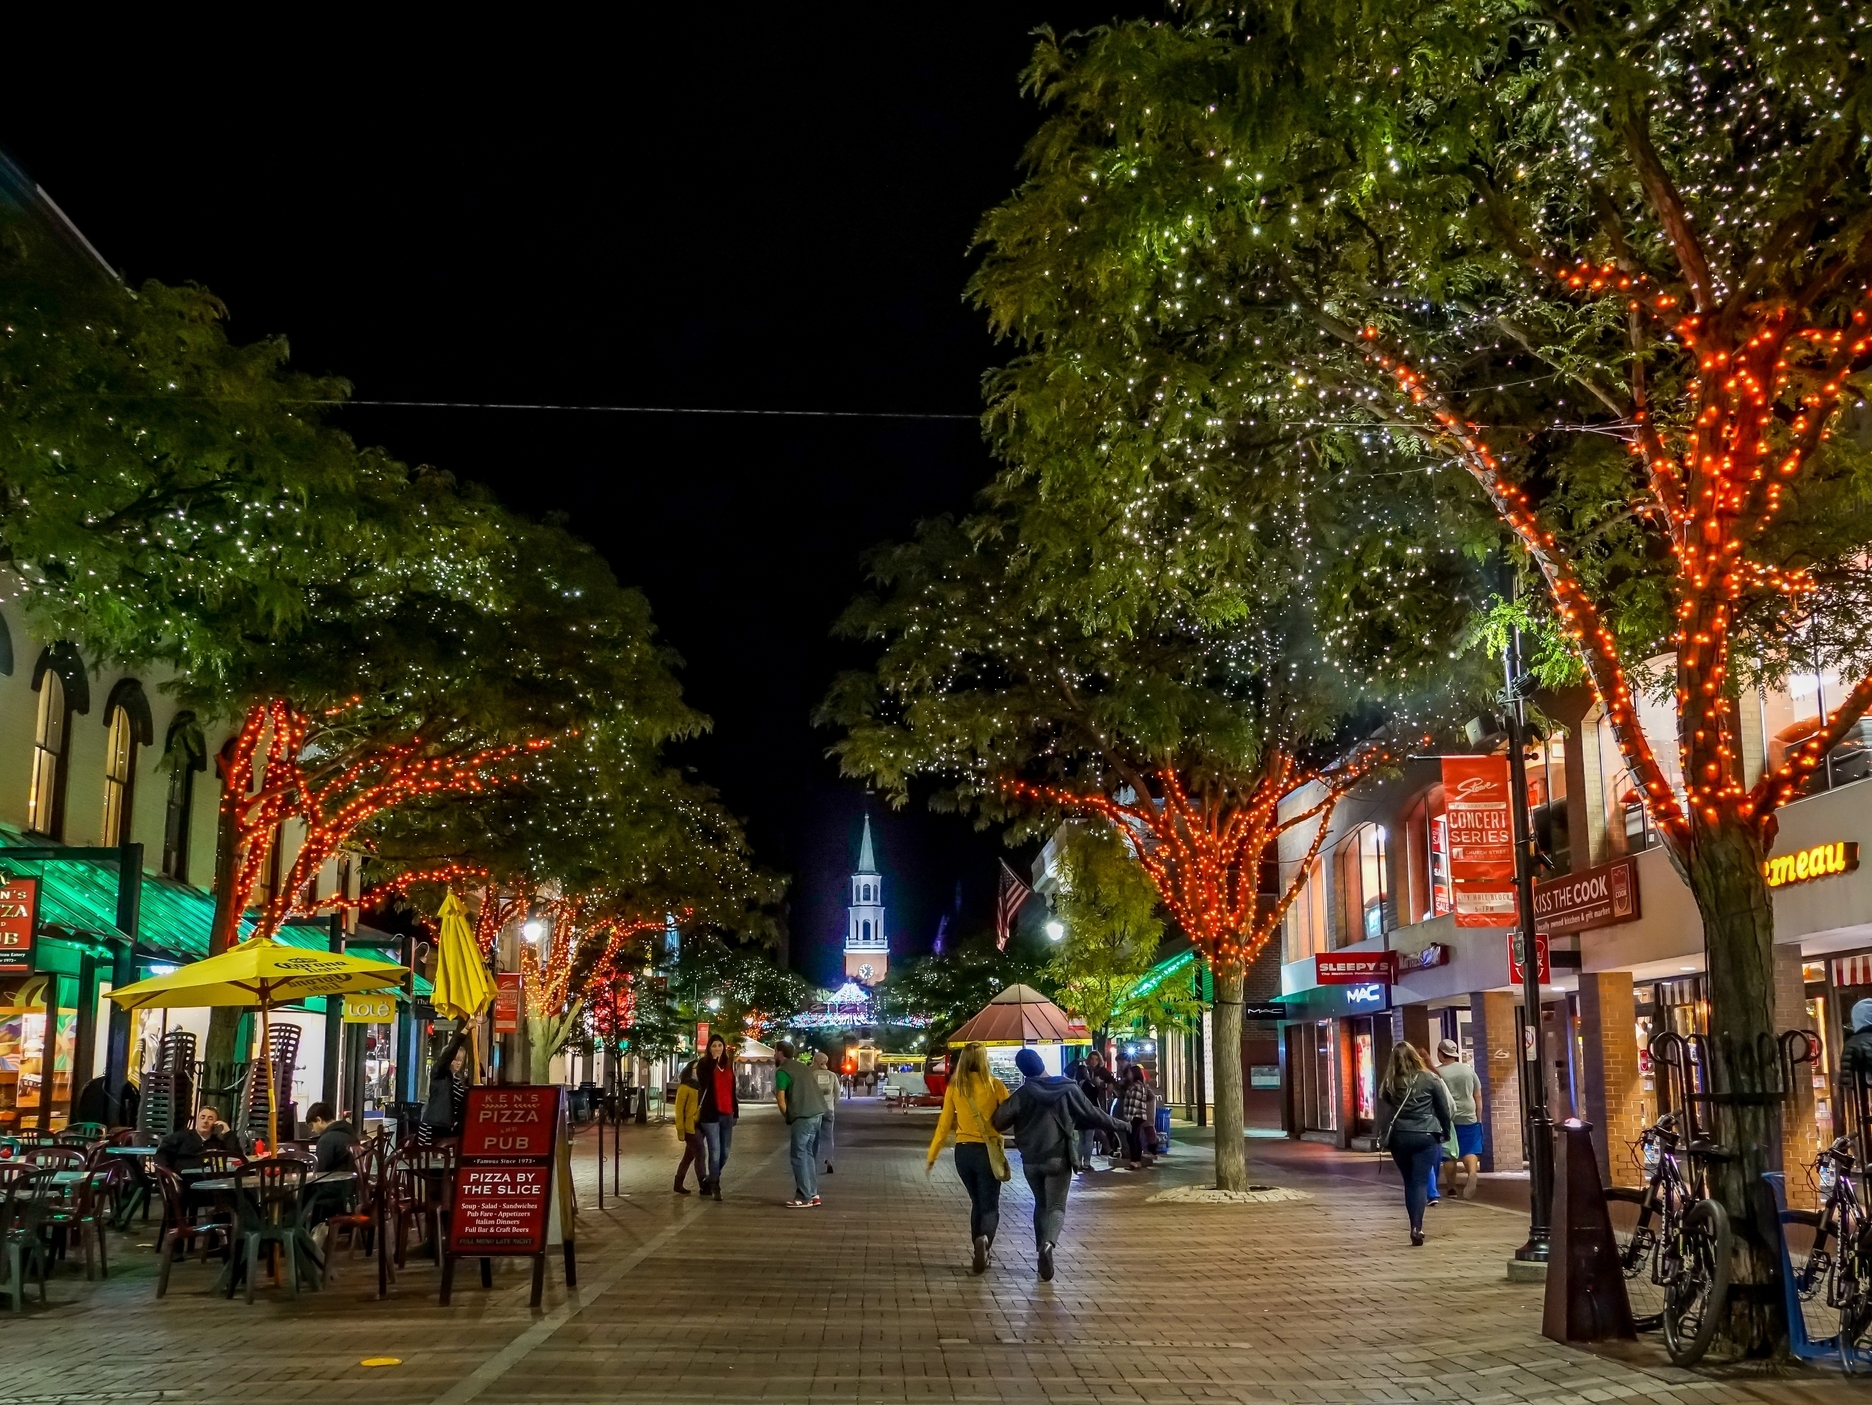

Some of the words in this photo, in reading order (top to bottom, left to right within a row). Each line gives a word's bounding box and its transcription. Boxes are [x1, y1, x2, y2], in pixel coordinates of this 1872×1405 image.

[1455, 777, 1498, 800] Stowe
[1449, 811, 1507, 829] CONCERT
[1450, 830, 1509, 843] SERIES
[1534, 891, 1552, 914] KISS
[1553, 886, 1573, 909] THE
[1573, 874, 1609, 904] COOK
[1537, 920, 1550, 931] locally
[1550, 918, 1564, 928] owned
[1564, 914, 1580, 927] kitchen
[1585, 911, 1594, 923] gift
[1594, 907, 1611, 917] market
[274, 961, 350, 971] Corona
[1346, 985, 1380, 1004] MAC
[485, 1094, 539, 1103] KEN'S
[479, 1110, 539, 1123] PIZZA
[500, 1126, 518, 1134] AND
[484, 1137, 529, 1150] PUB
[470, 1173, 511, 1182] PIZZA
[516, 1173, 536, 1182] BY
[463, 1185, 492, 1194] THE
[497, 1185, 541, 1194] SLICE
